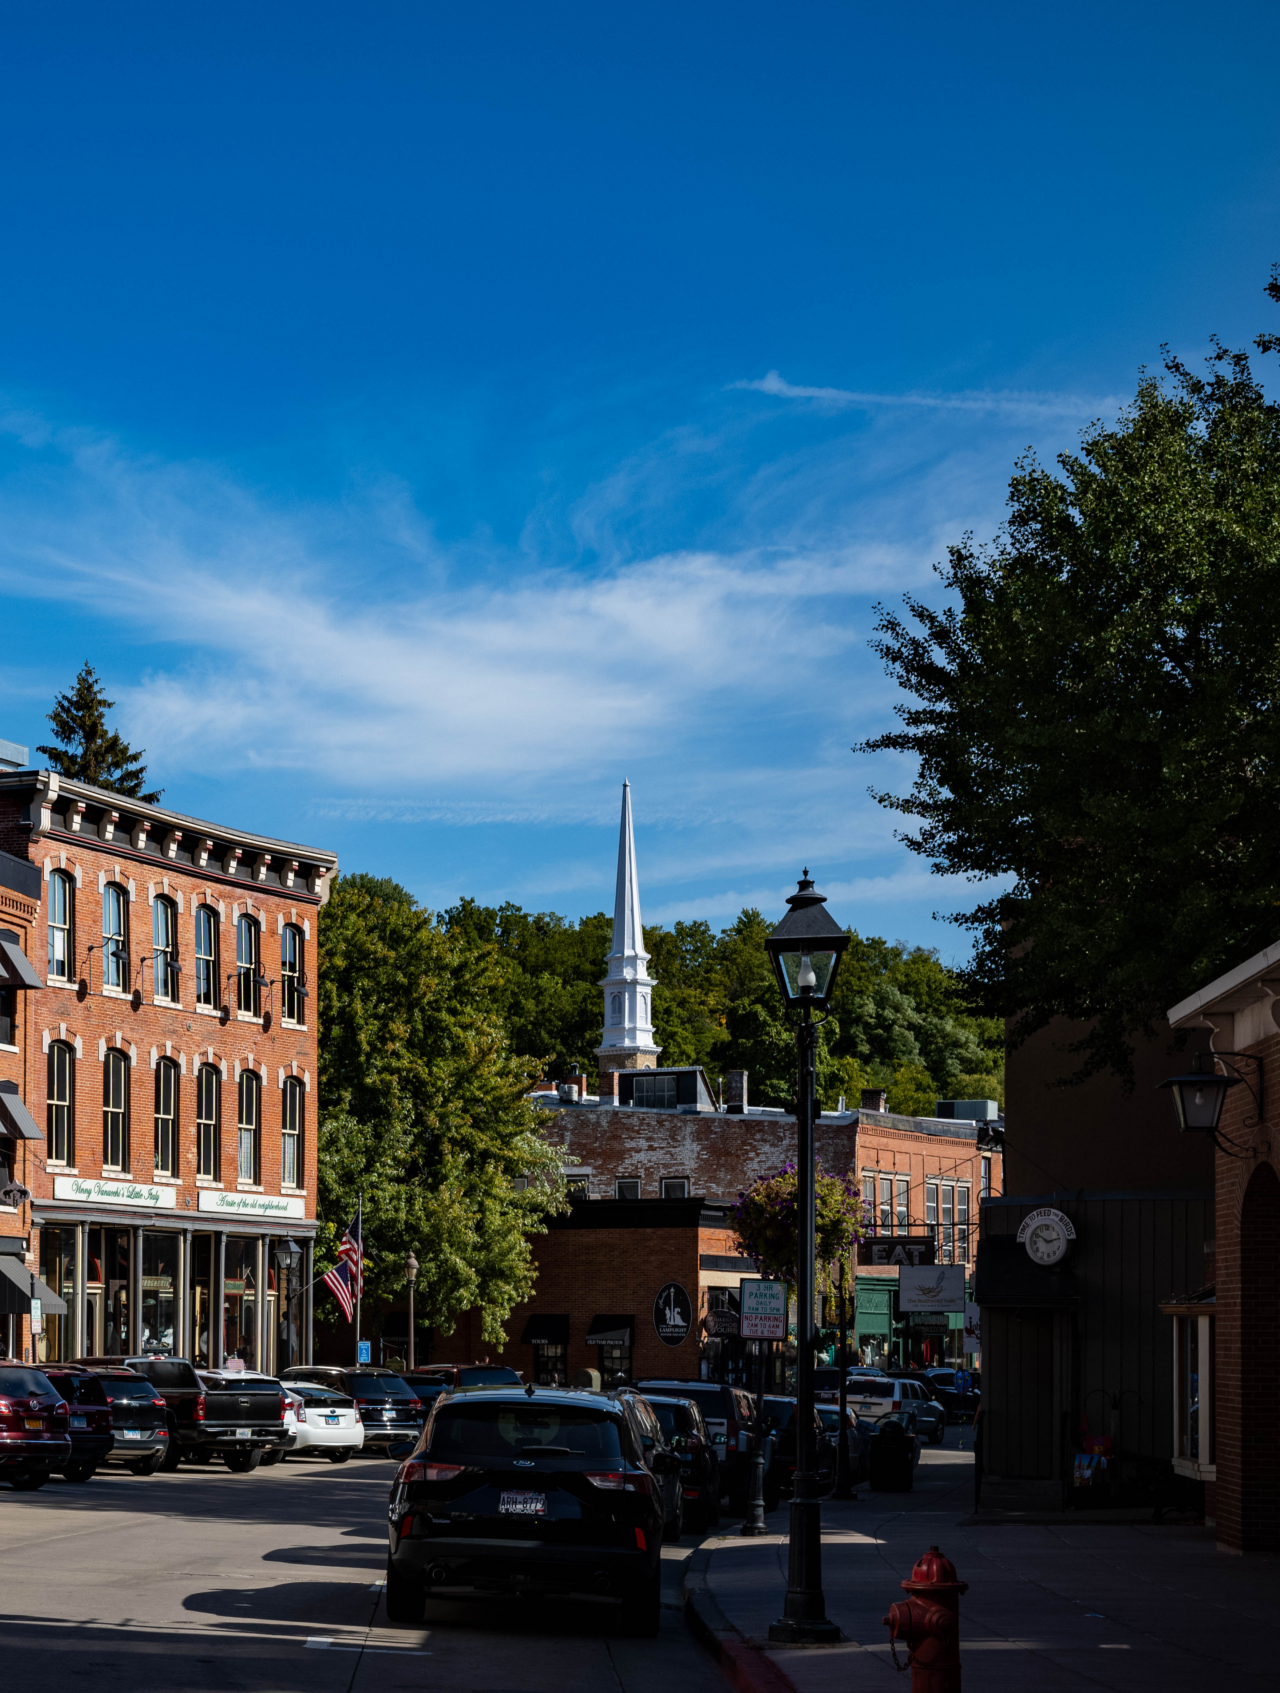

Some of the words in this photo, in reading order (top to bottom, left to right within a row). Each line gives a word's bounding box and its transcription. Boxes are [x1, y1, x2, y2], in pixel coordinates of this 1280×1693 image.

[71, 1179, 93, 1200] Vinny
[250, 1199, 258, 1208] old
[1018, 1220, 1029, 1239] TIME
[1029, 1214, 1036, 1222] TO
[1036, 1209, 1051, 1218] FEED
[1059, 1215, 1074, 1236] BIRDS
[872, 1245, 925, 1265] EAT
[763, 1284, 773, 1292] HR
[749, 1292, 780, 1300] PARKING
[755, 1315, 783, 1323] PARKING
[500, 1496, 545, 1509] ARH-8779
